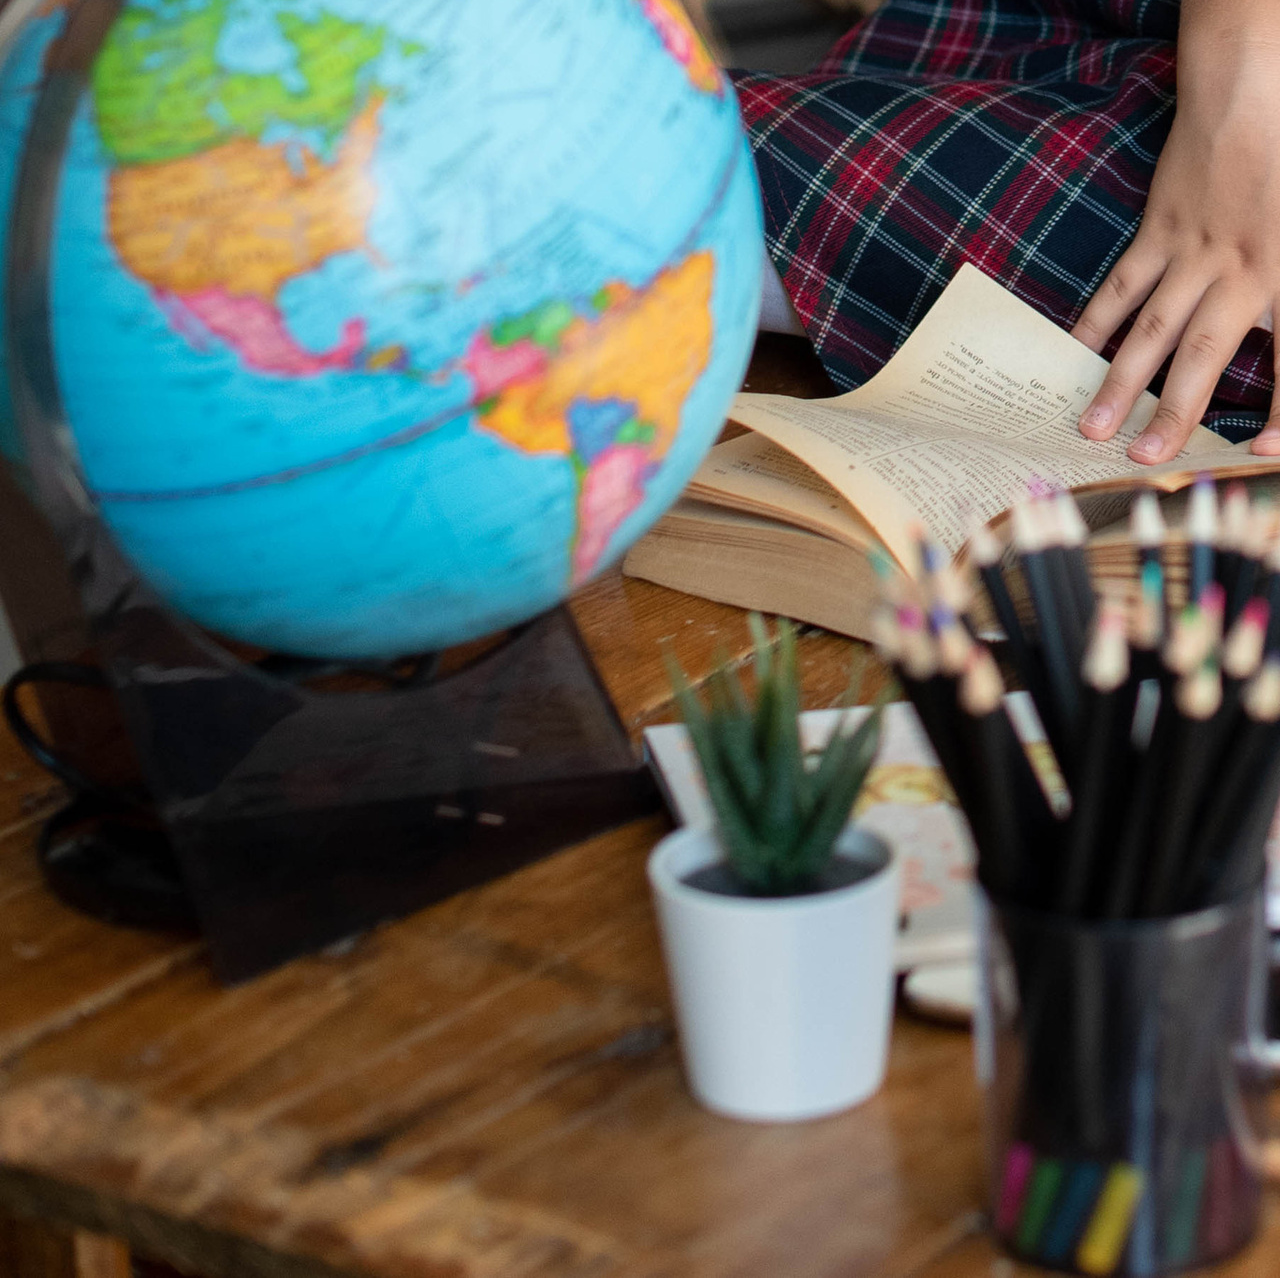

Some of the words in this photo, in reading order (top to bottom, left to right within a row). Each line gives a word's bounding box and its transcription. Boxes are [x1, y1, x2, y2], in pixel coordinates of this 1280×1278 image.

[925, 367, 940, 380] the
[1029, 378, 1046, 392] off)
[1074, 385, 1090, 398] 175
[973, 382, 1005, 404] minutes
[1004, 389, 1015, 399] 20
[1005, 400, 1016, 409] 20
